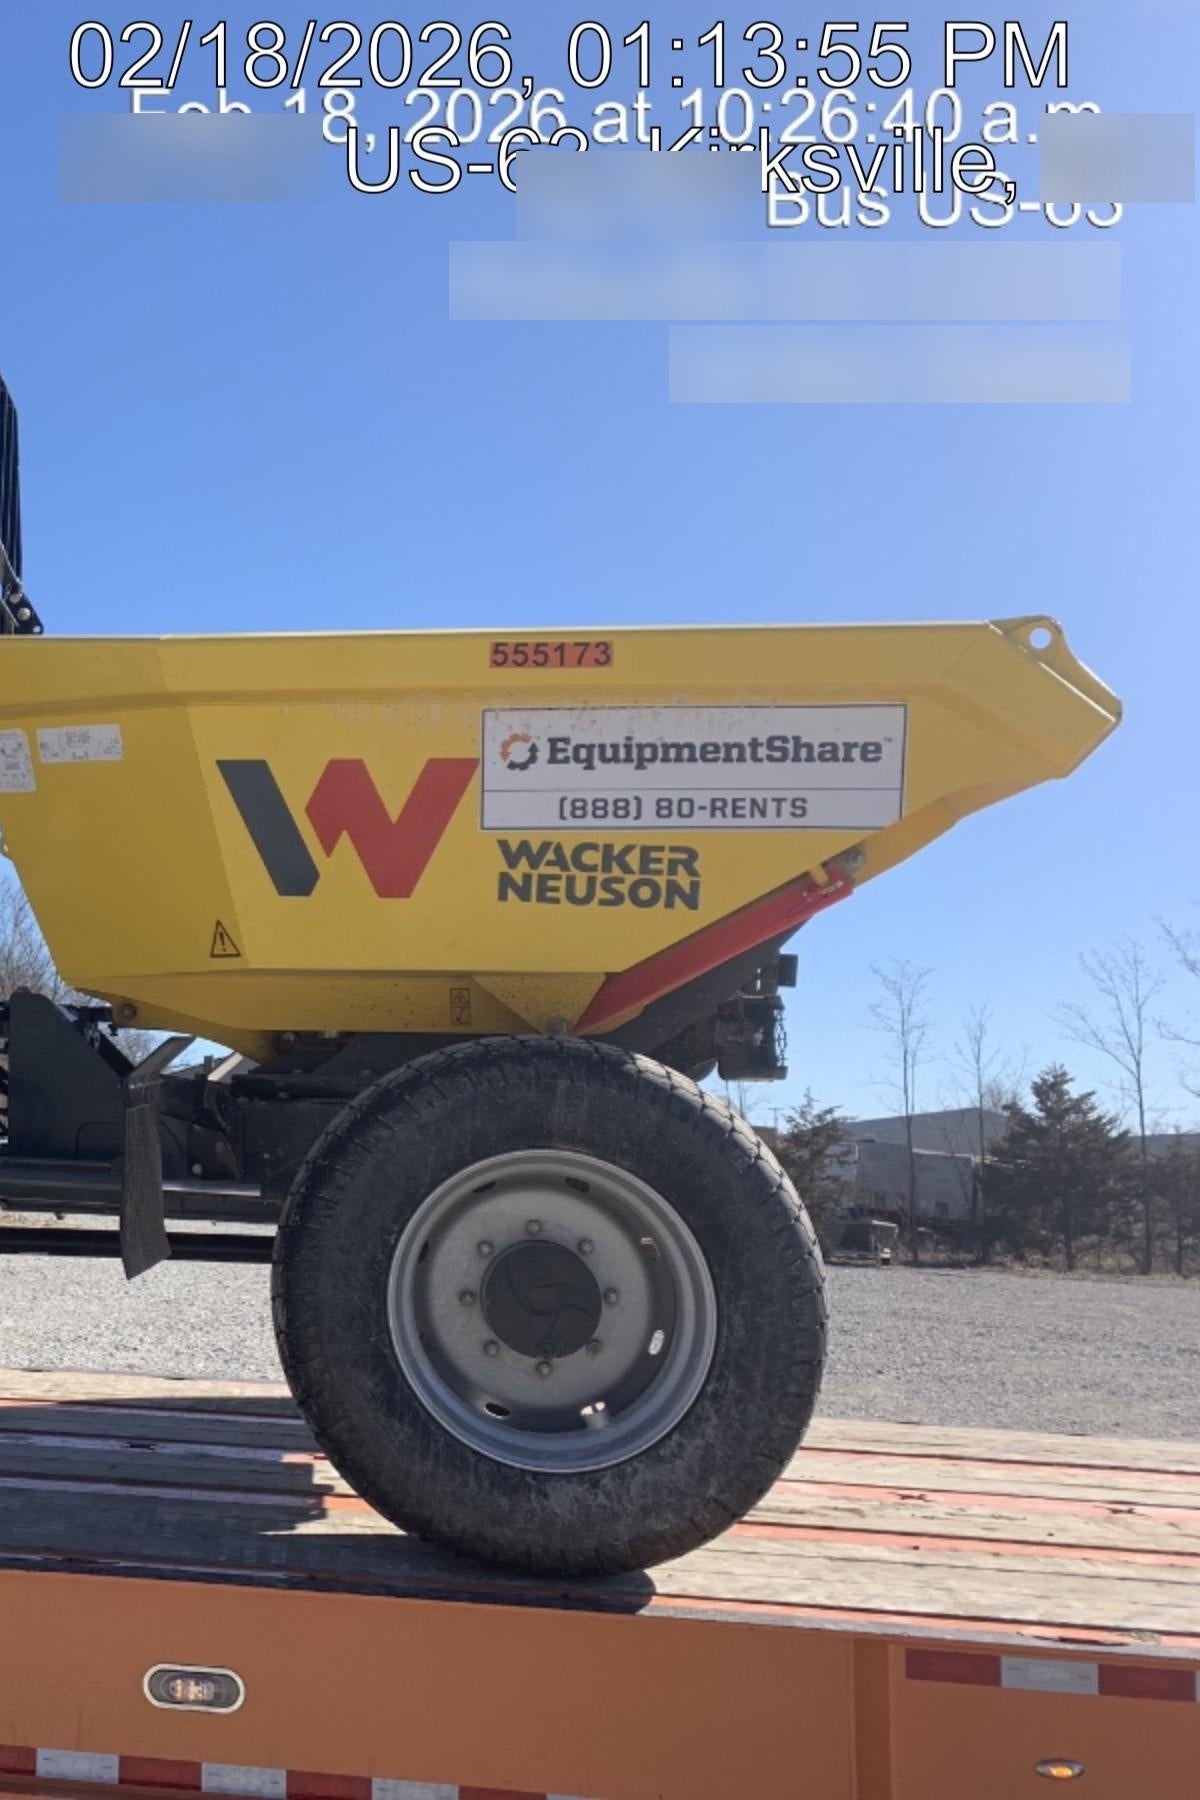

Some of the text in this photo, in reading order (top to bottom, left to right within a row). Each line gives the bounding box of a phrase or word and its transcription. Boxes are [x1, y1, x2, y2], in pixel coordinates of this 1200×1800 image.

[491, 640, 612, 668] 555173
[547, 734, 883, 771] EquipmentShare
[558, 795, 809, 822] (888) 80-RENTS
[497, 838, 700, 878] WACKER
[497, 871, 700, 911] NEUSON
